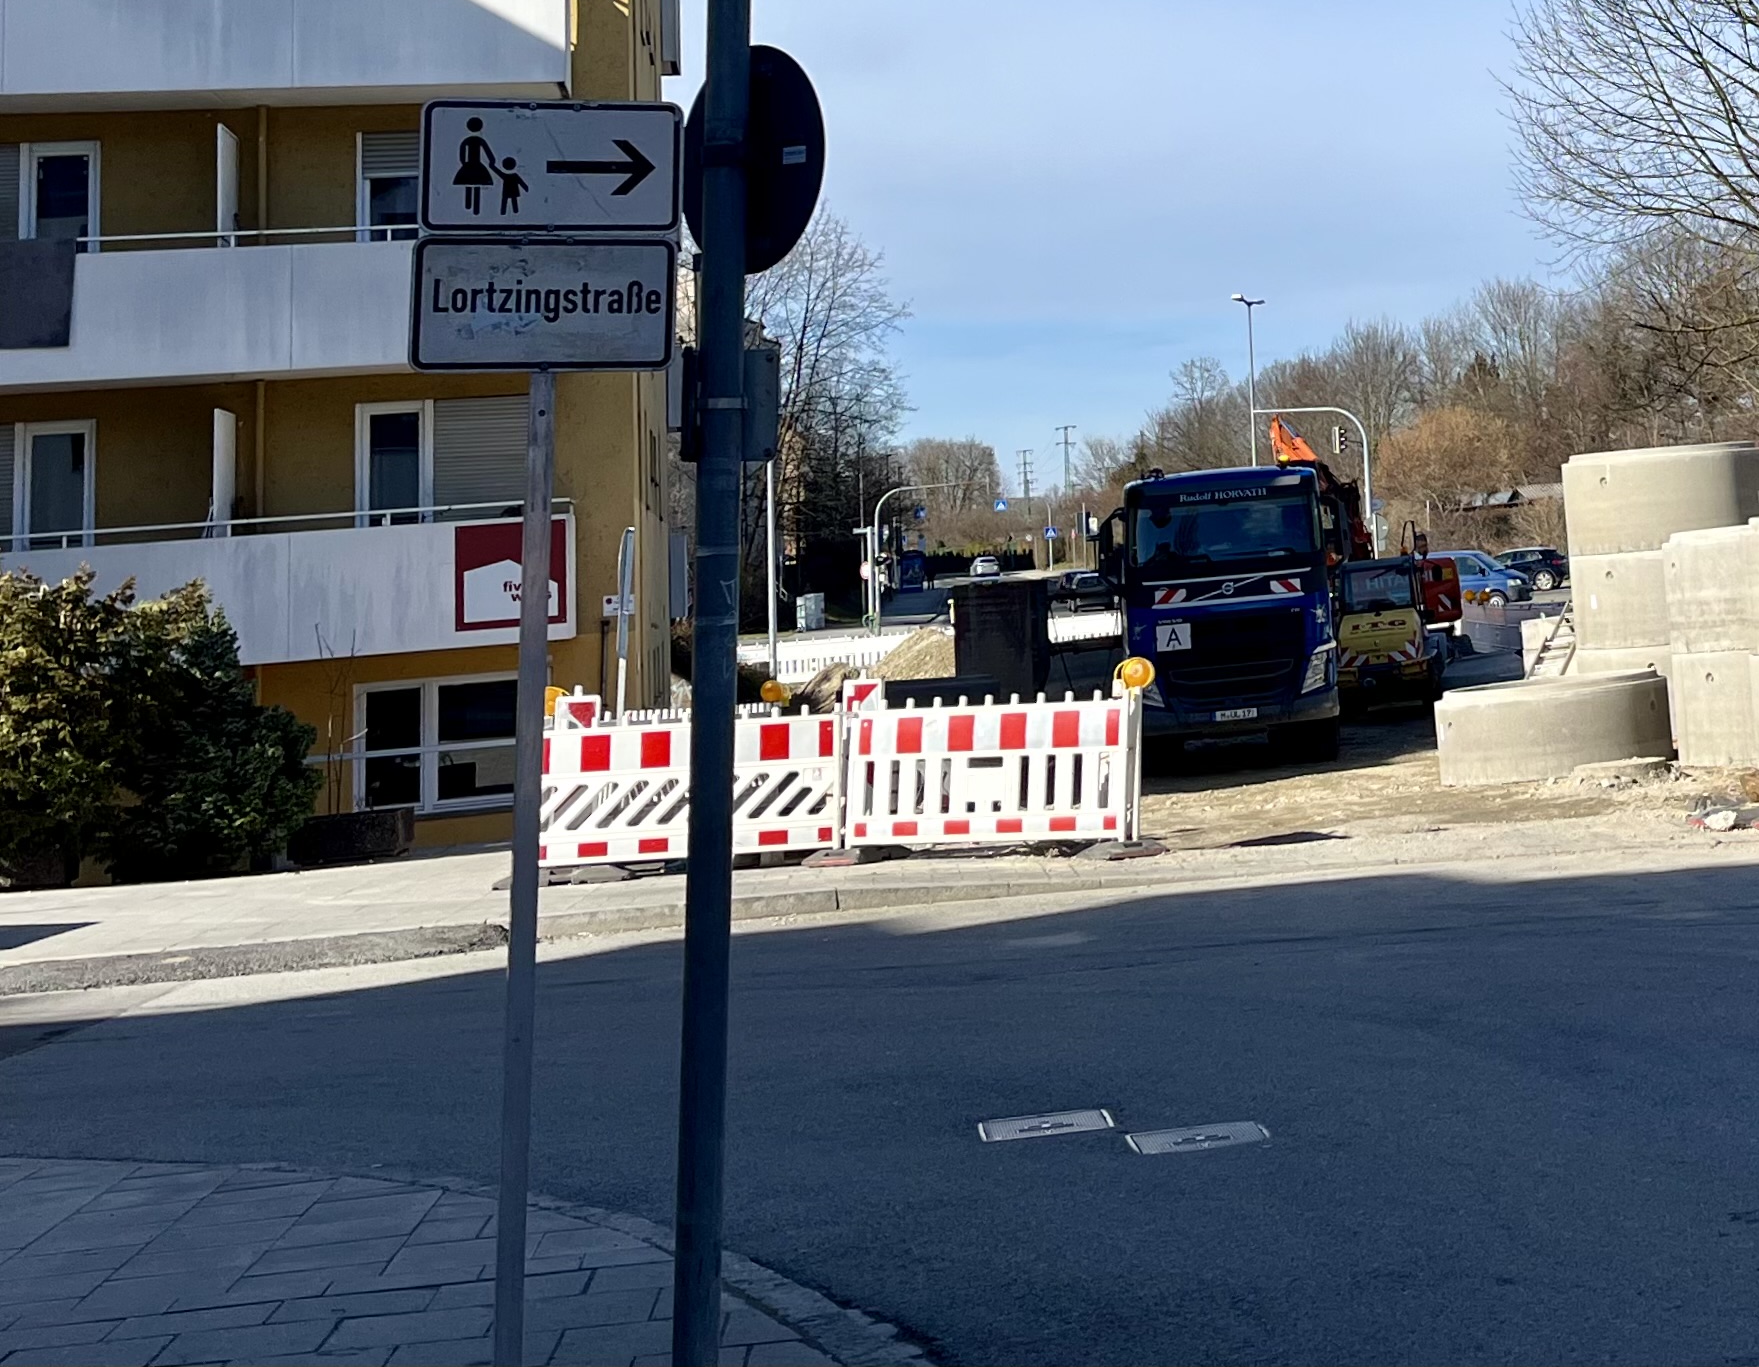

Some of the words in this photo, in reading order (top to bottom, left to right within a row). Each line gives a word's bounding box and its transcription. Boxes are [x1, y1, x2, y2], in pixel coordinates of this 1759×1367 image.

[432, 278, 662, 323] Lortzingstraße
[1180, 492, 1211, 502] Rudolf
[1214, 487, 1267, 499] HORVATH
[503, 581, 523, 592] fiv
[1166, 627, 1182, 647] A
